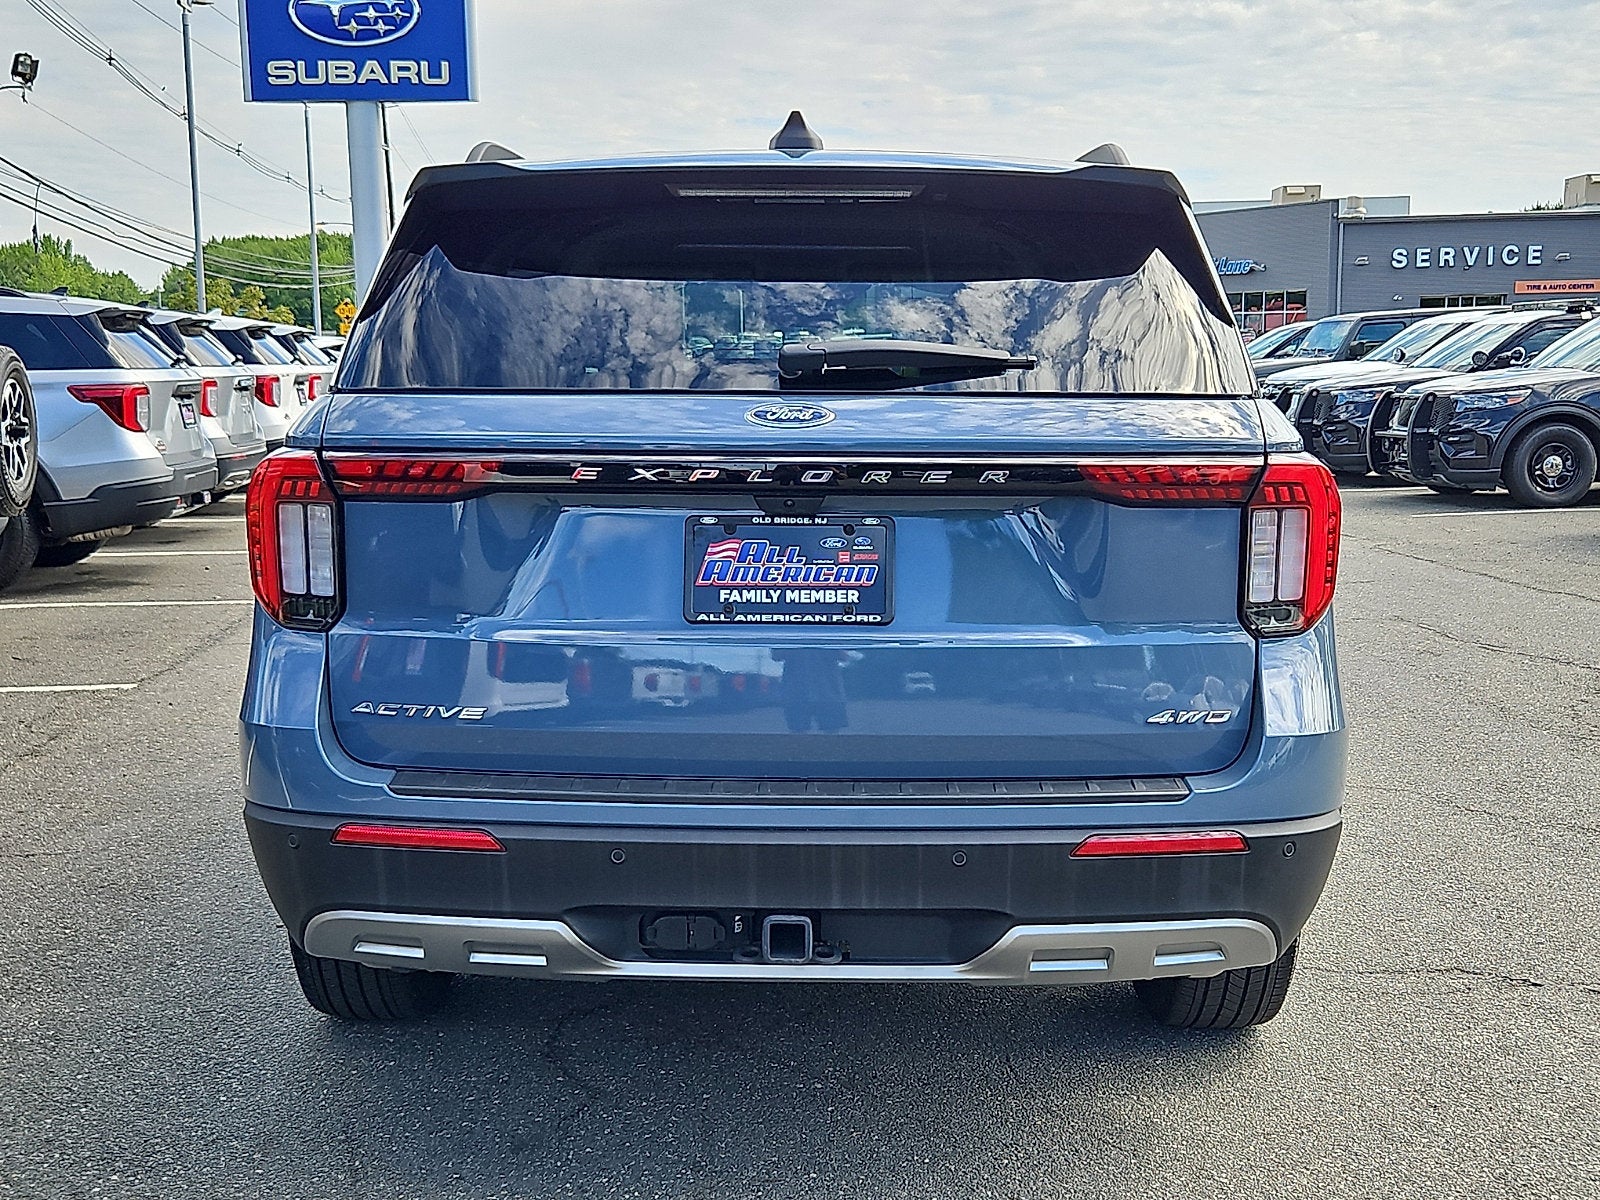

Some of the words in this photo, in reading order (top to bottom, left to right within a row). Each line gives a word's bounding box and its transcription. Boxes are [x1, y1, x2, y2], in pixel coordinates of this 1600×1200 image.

[266, 59, 451, 85] SUBARU
[1390, 244, 1544, 269] SERVICE
[1218, 256, 1254, 275] Lane
[1548, 283, 1567, 291] AUTO
[570, 466, 1011, 485] EXPLORER
[752, 516, 772, 525] OLD
[814, 516, 828, 525] NJ
[719, 588, 782, 604] FAMILY
[785, 588, 860, 604] MEMBER
[696, 612, 731, 622] ALL
[734, 613, 827, 623] AMERICAN
[831, 613, 882, 623] FORD
[350, 701, 488, 720] ACTIVE
[1146, 709, 1232, 724] 4WD
